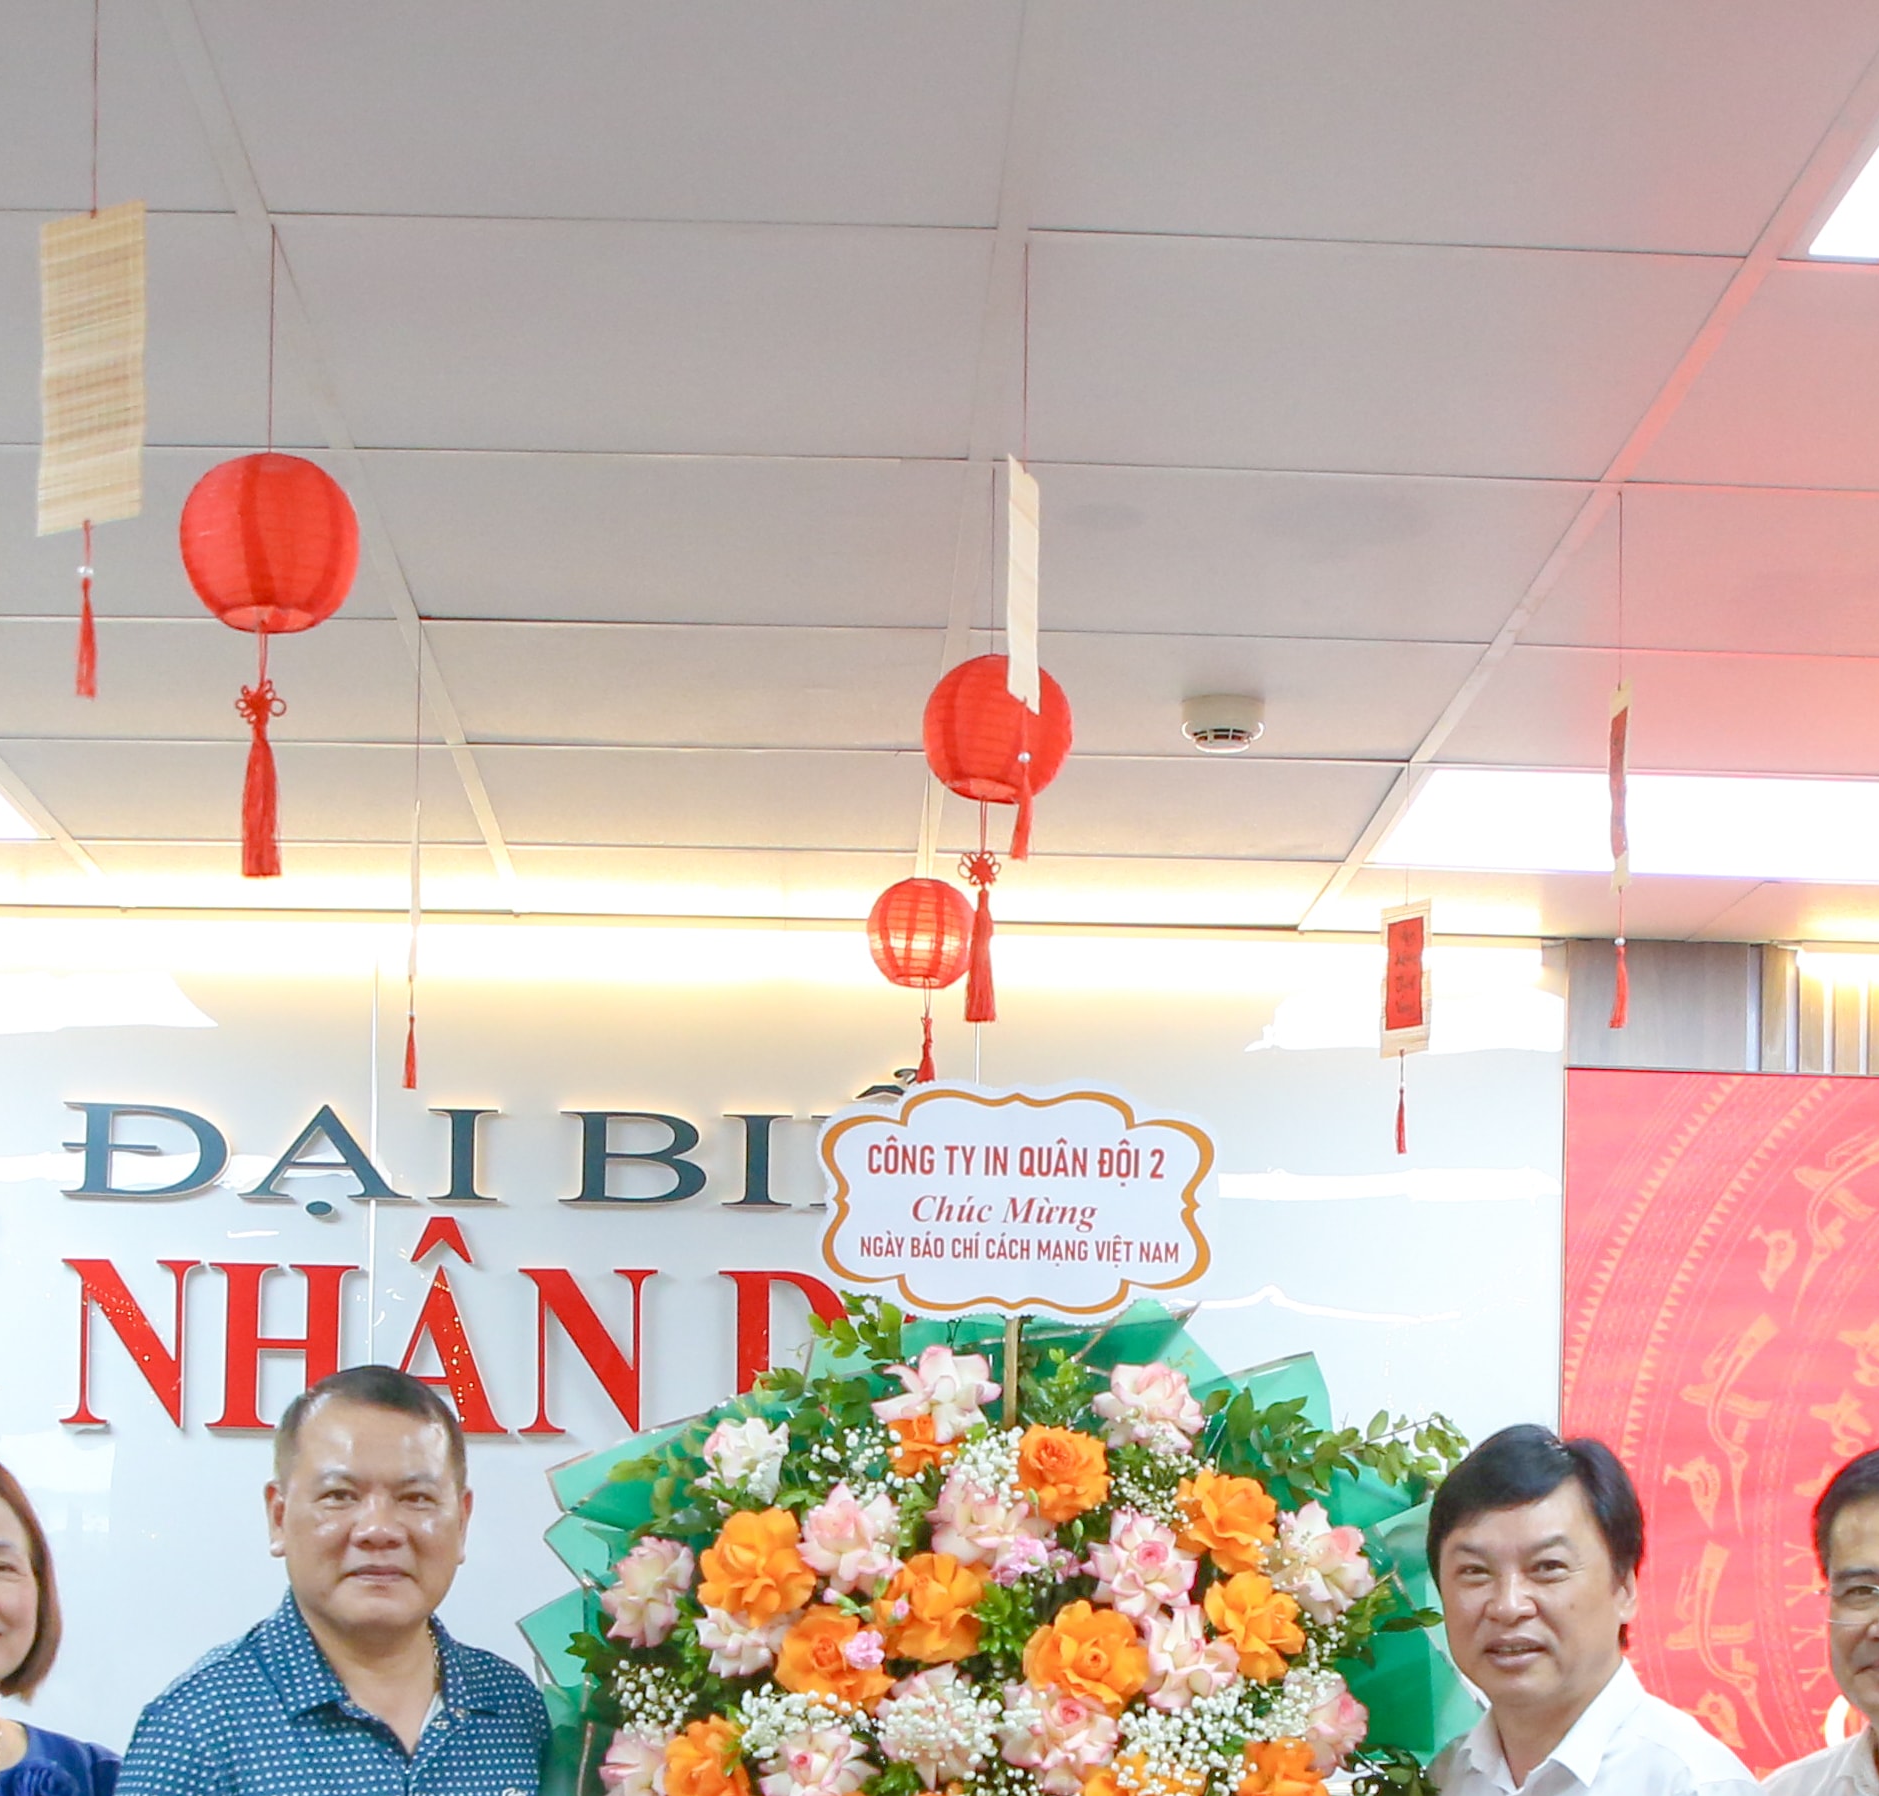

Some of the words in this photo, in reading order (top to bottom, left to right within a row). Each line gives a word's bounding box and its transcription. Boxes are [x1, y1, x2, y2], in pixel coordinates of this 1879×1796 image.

[59, 1100, 502, 1217] ĐẠI
[867, 1133, 935, 1176] CÔNG
[944, 1145, 976, 1176] TY
[984, 1146, 1008, 1177] IN
[1019, 1137, 1087, 1178] QUÂN
[1098, 1138, 1140, 1187] ĐỘI
[1149, 1148, 1165, 1180] 2
[912, 1194, 993, 1223] Chúc
[1002, 1196, 1098, 1233] Mừng
[860, 1231, 905, 1259] NGÀY
[910, 1231, 945, 1259] BÁO
[951, 1232, 980, 1260] CHÍ
[986, 1232, 1031, 1261] CÁCH
[1037, 1239, 1089, 1267] MẠNG
[1095, 1235, 1133, 1268] VIỆT
[1139, 1242, 1179, 1264] NAM
[59, 1216, 659, 1434] NHÂN
